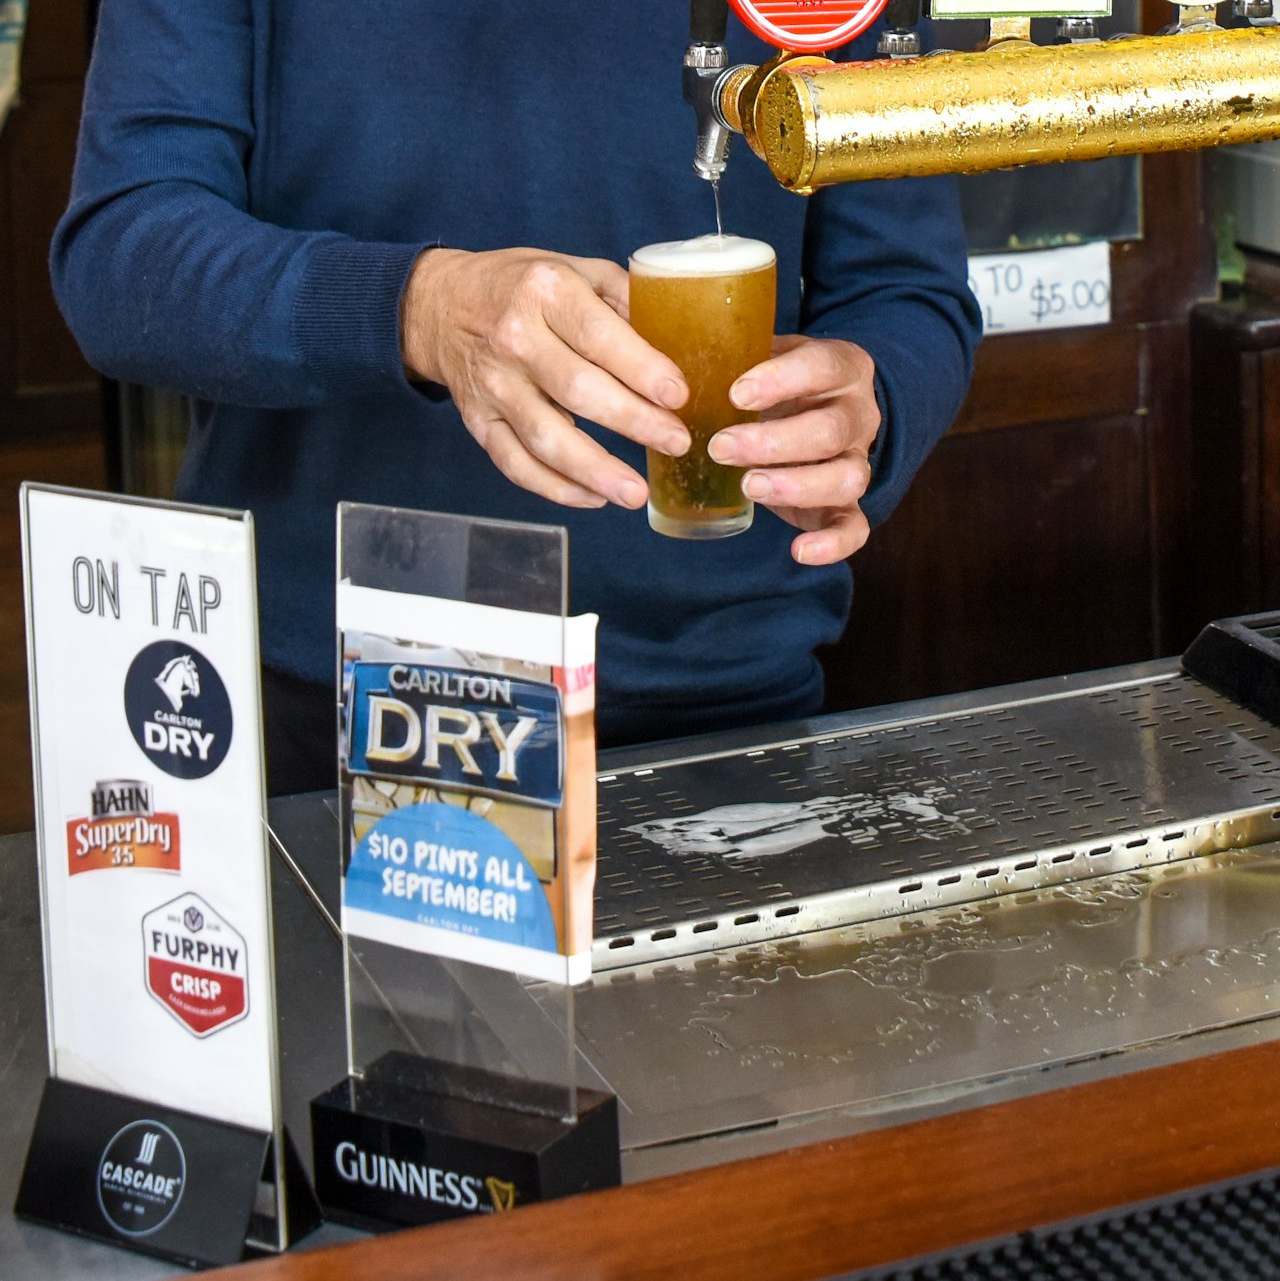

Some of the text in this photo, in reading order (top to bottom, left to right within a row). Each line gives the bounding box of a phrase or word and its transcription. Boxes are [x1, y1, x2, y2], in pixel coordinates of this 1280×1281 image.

[986, 264, 1023, 296] TO
[1029, 278, 1107, 323] $5.00
[72, 556, 222, 635] ON TAP
[388, 664, 512, 704] CARLTON
[154, 710, 202, 730] CARLTON
[365, 694, 538, 782] DRY
[143, 720, 215, 762] DRY
[91, 786, 150, 817] HAHN
[75, 817, 172, 858] SuperDry
[368, 830, 532, 891] $10 PINTS ALL
[382, 866, 517, 924] SEPTEMBER!
[417, 914, 460, 930] CARLTON
[152, 930, 239, 972] FURPHY
[170, 971, 222, 1001] CRISP
[101, 1161, 174, 1199] CASCADE
[334, 1141, 479, 1211] GUINNESS
